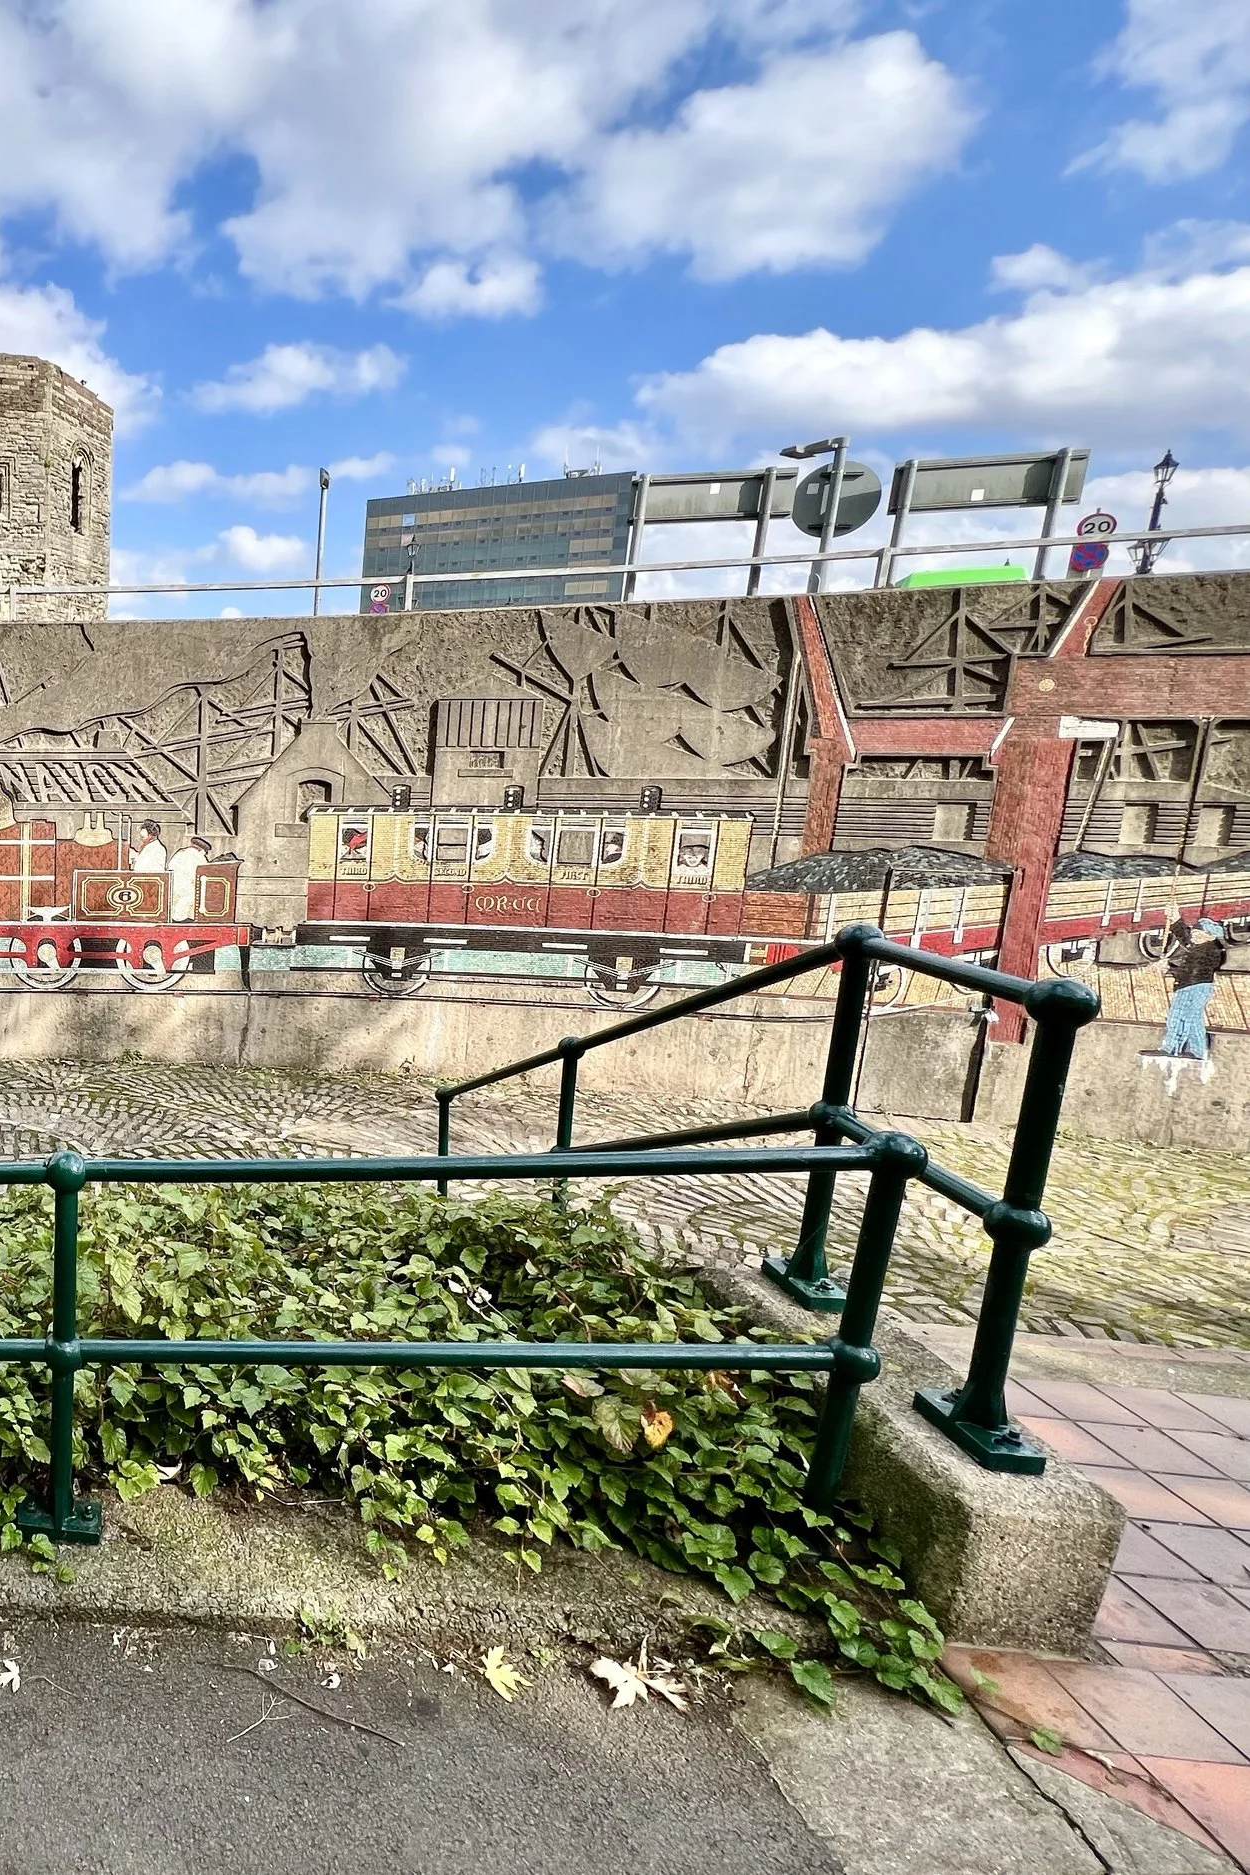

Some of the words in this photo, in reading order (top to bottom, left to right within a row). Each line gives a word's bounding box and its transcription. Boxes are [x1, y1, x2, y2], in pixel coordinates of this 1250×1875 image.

[1085, 521, 1110, 534] 20
[374, 590, 387, 598] 20
[340, 867, 367, 876] THIRD
[434, 868, 467, 877] SECOND
[119, 891, 132, 901] 6
